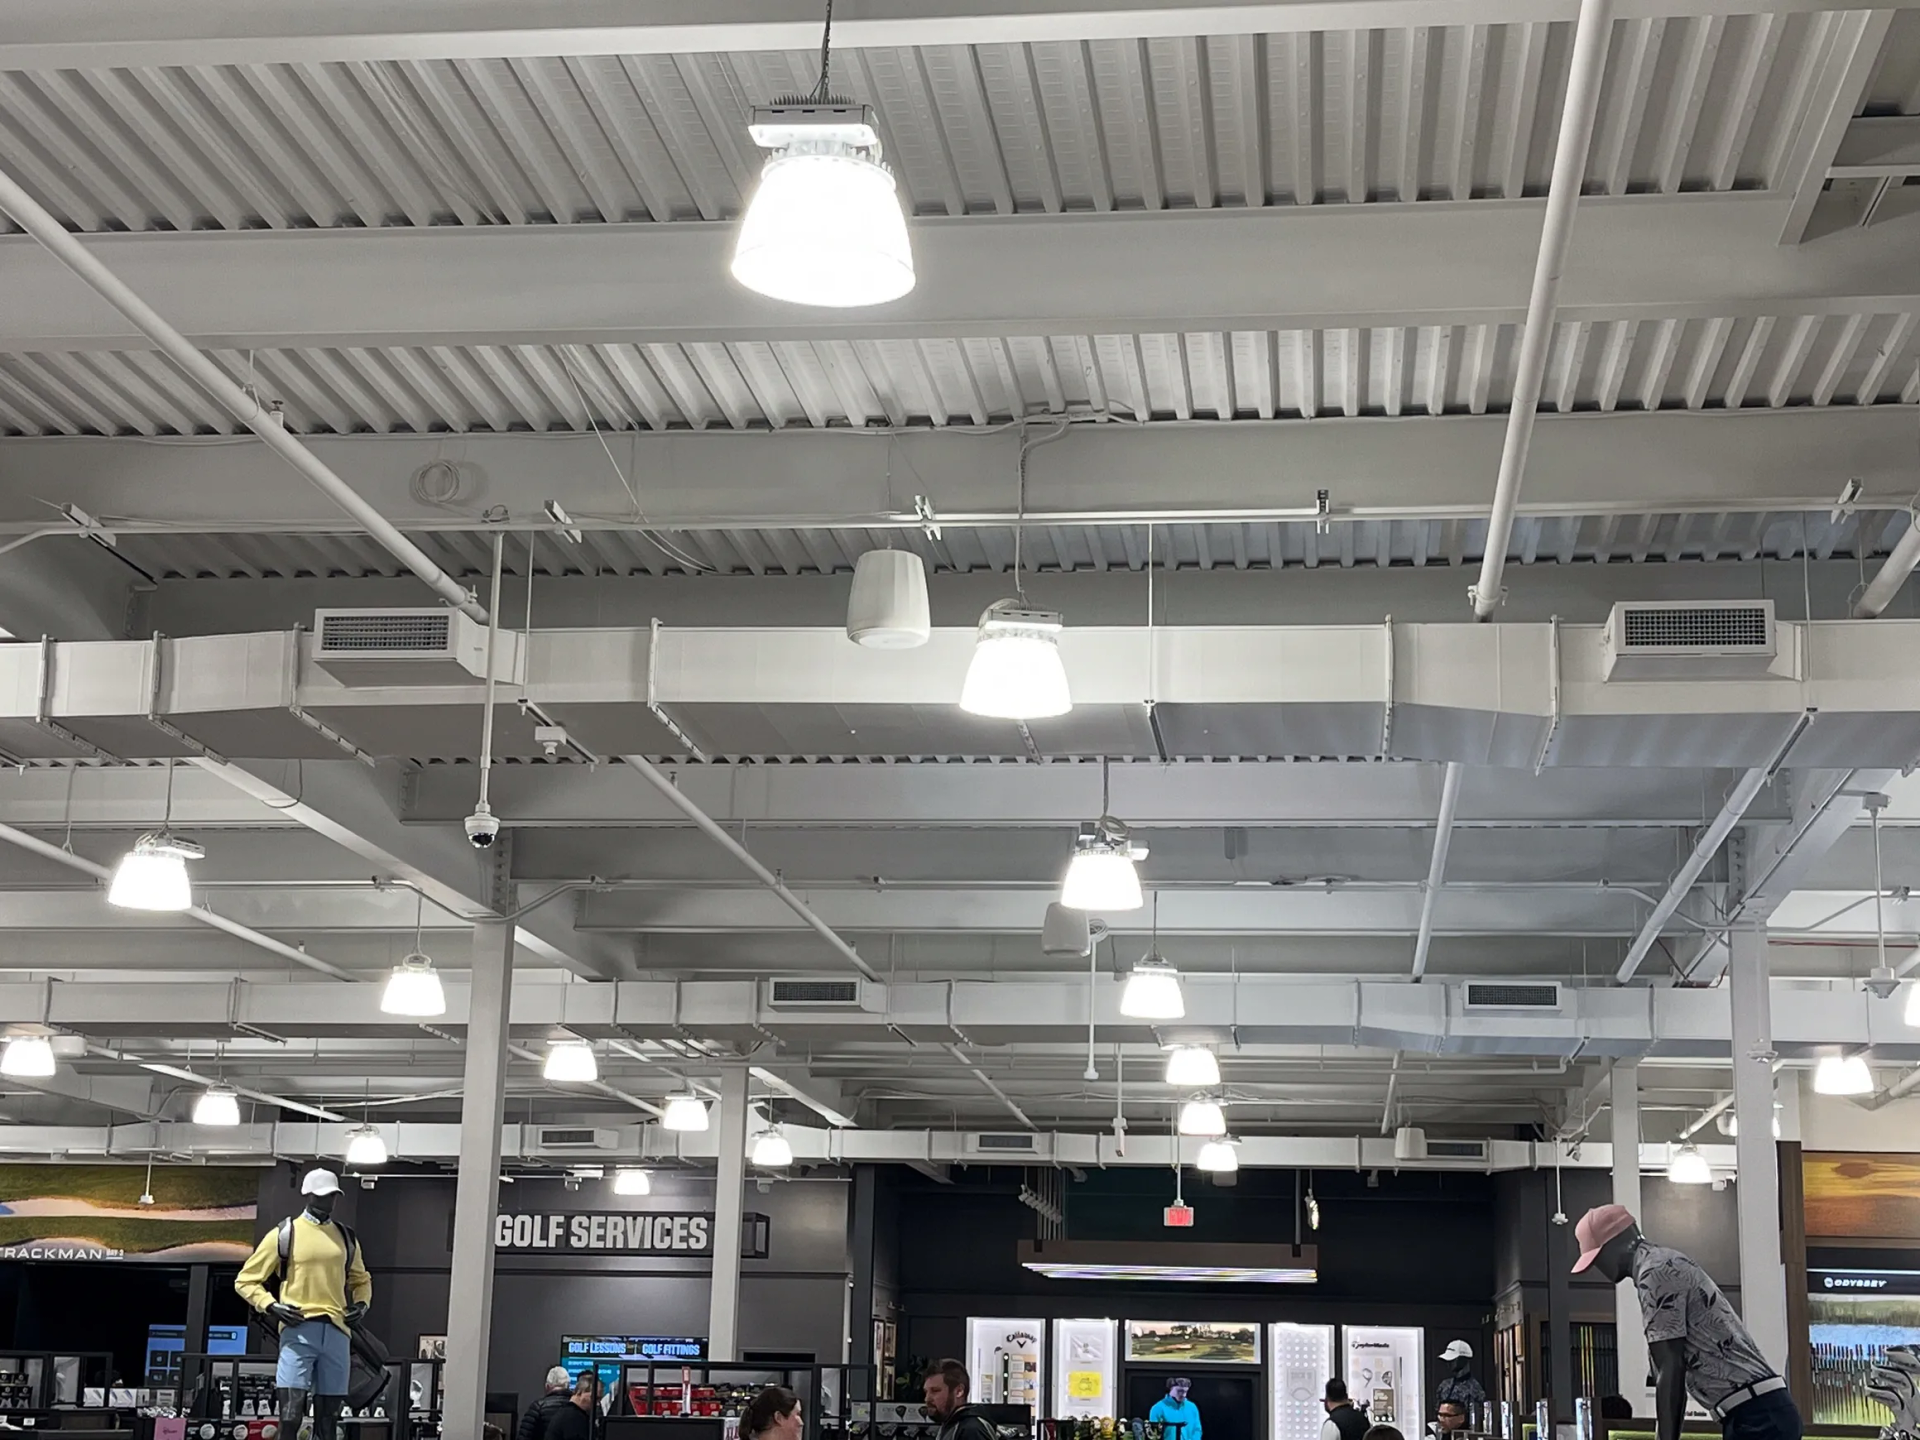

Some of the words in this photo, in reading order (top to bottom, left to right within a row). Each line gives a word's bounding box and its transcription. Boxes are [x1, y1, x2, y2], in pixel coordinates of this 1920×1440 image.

[495, 1215, 565, 1247] GOLF
[570, 1215, 708, 1249] SERVICES
[1834, 1279, 1887, 1288] ODYSSEY
[568, 1342, 589, 1354] GOLF
[590, 1342, 627, 1354] LESSONS
[642, 1343, 662, 1355] GOLF
[663, 1344, 700, 1355] FITTINGS
